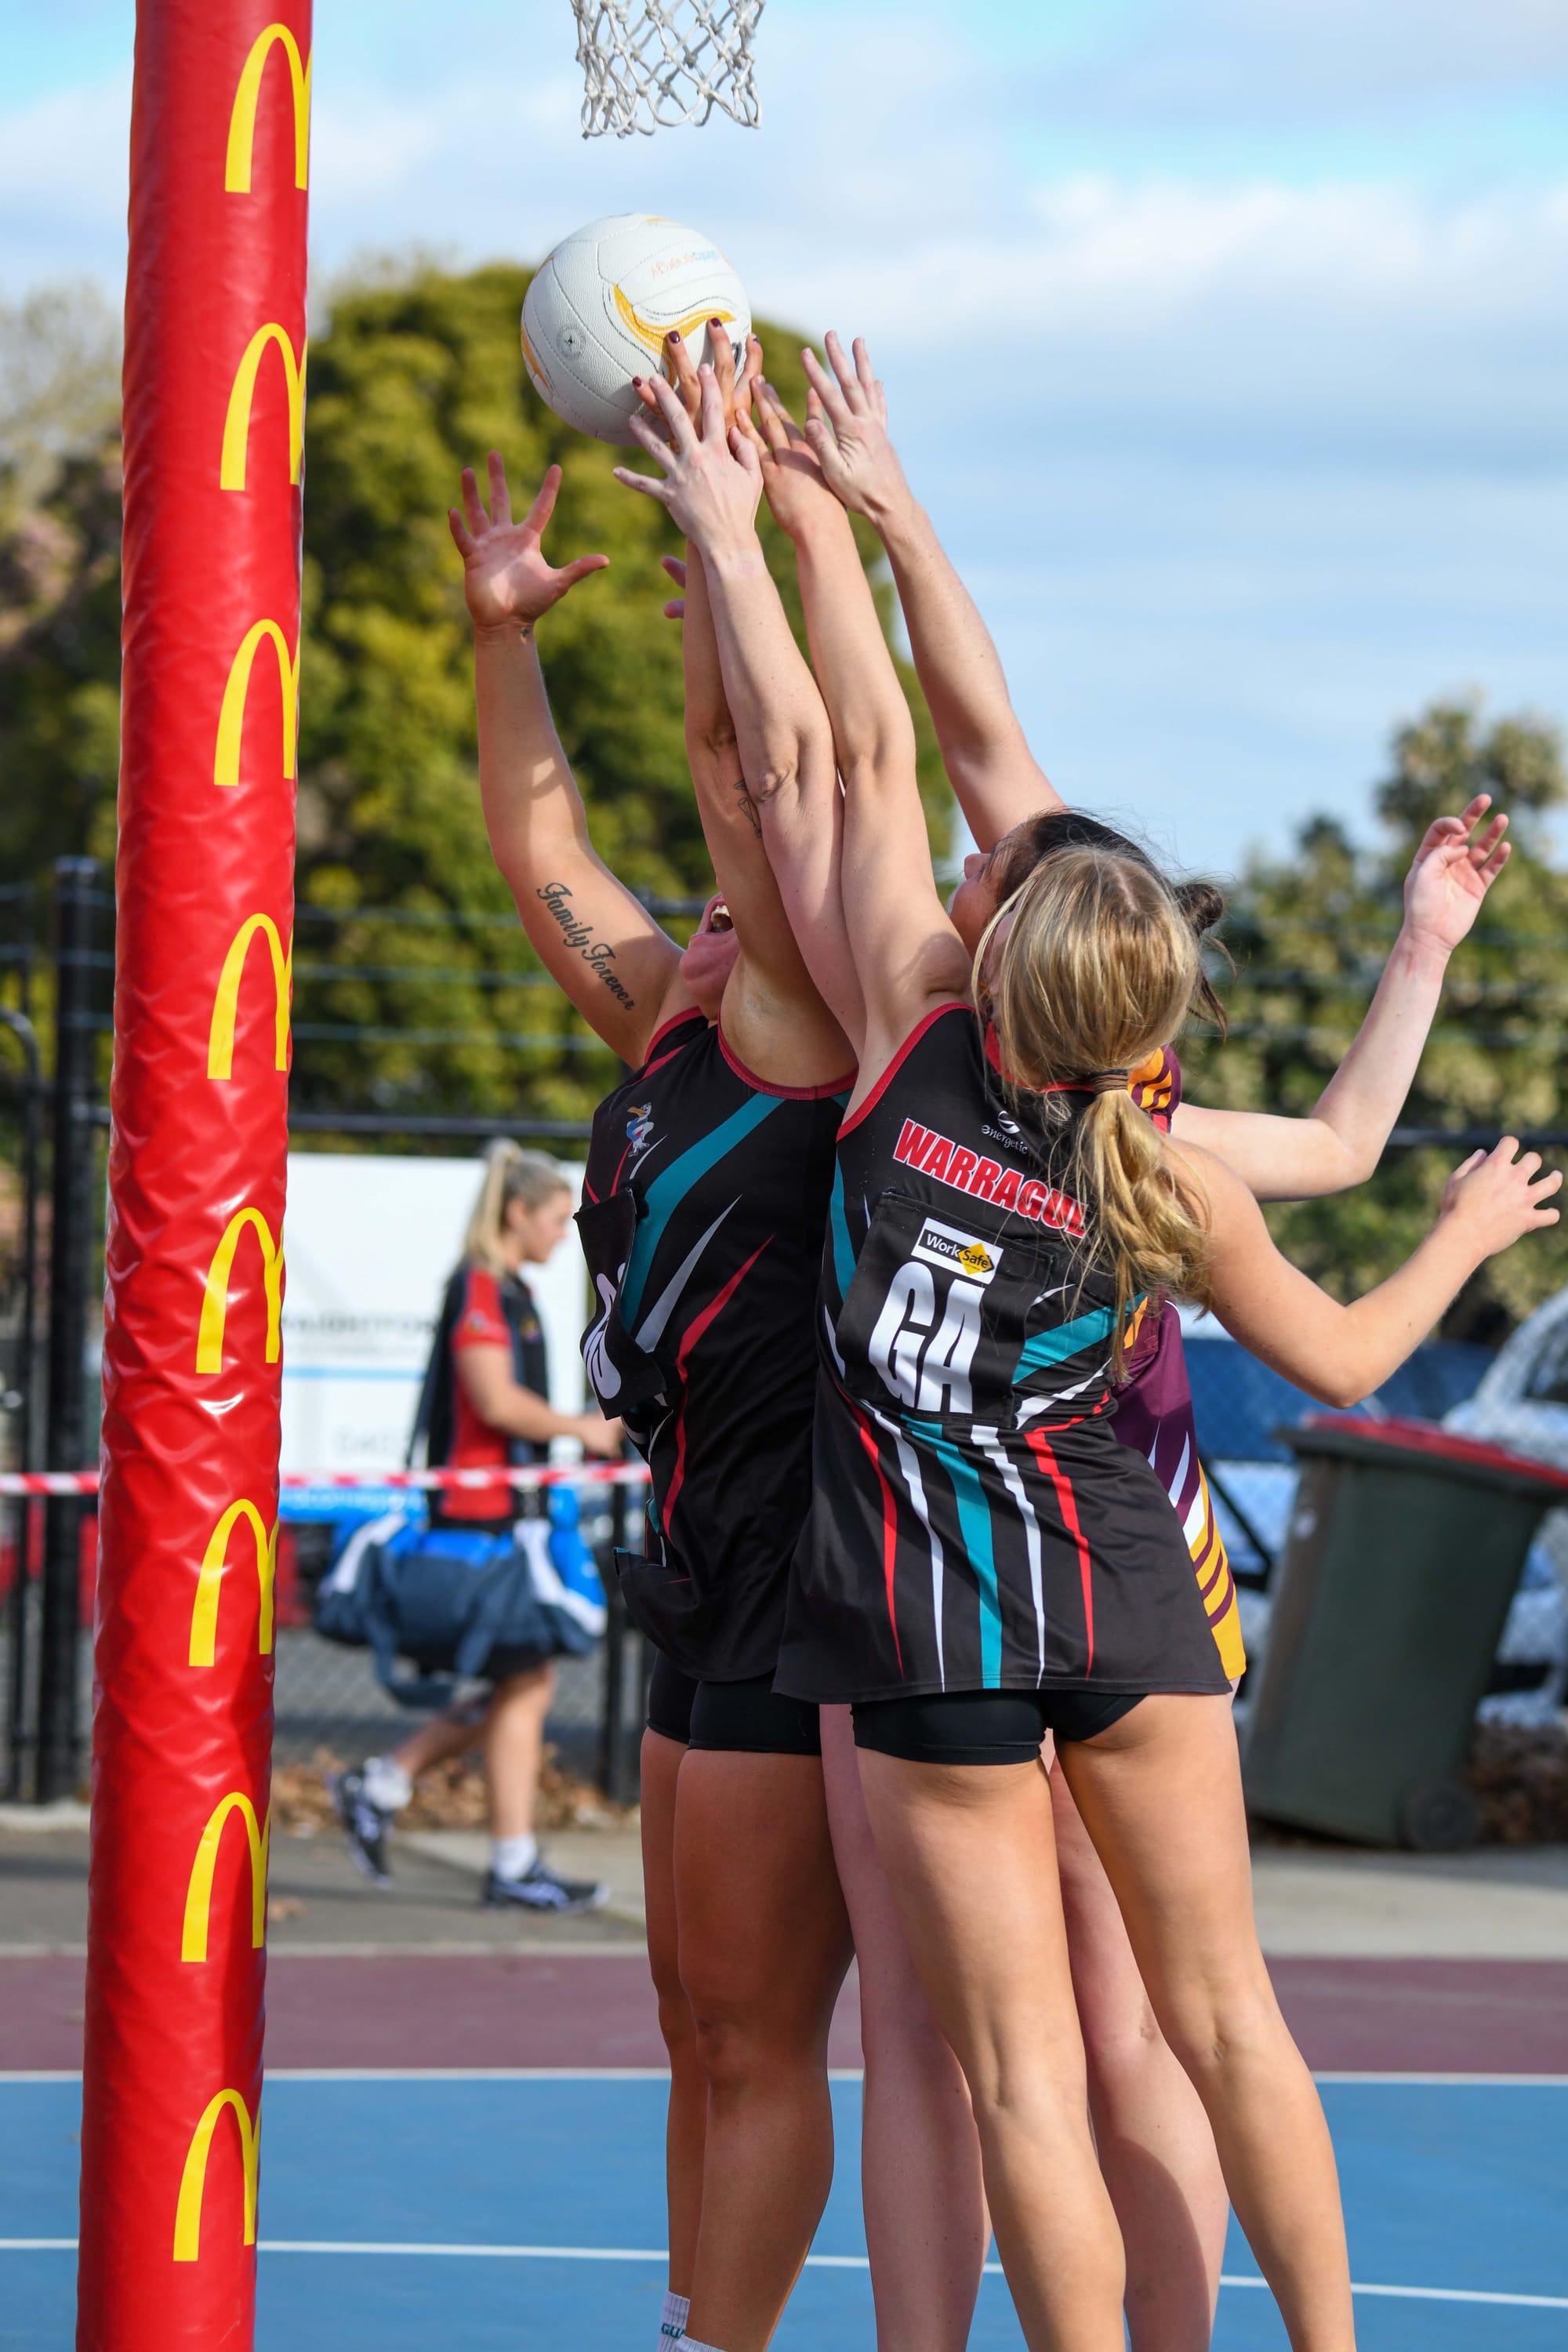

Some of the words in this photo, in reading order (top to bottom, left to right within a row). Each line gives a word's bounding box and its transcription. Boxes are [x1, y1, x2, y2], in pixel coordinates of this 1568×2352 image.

[536, 882, 593, 948] Family
[582, 943, 635, 1011] Forever
[893, 1118, 1088, 1239] WARRAGUL
[981, 1124, 1029, 1154] energetic
[869, 1261, 985, 1414] GA
